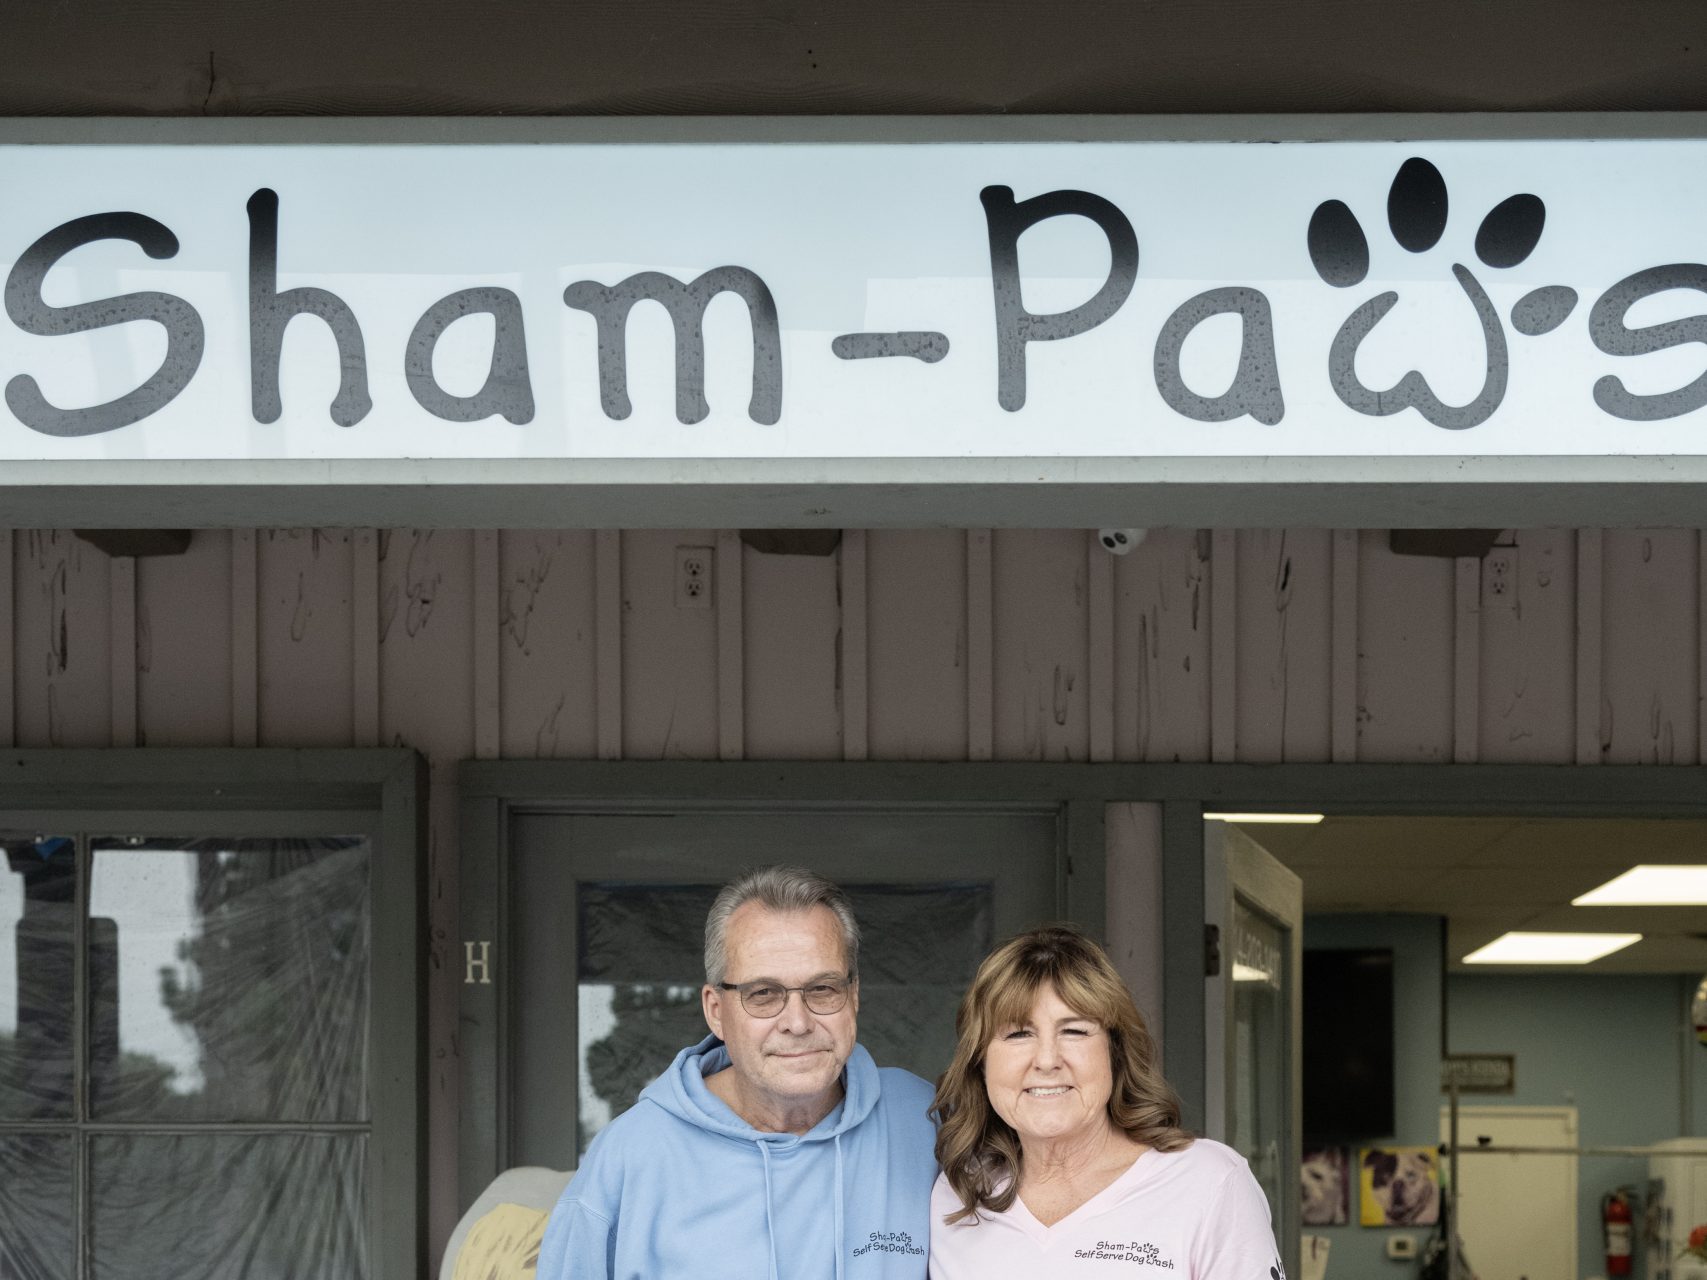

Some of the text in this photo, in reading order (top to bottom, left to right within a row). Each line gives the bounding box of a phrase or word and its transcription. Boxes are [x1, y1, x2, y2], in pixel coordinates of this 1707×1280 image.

[464, 941, 491, 983] H
[853, 1243, 872, 1257] Self
[889, 1243, 905, 1254] Dog
[1096, 1241, 1160, 1254] Sham-Paws
[1074, 1249, 1096, 1258] Self
[1095, 1250, 1124, 1259] Serve
[1125, 1253, 1145, 1264] Dog
